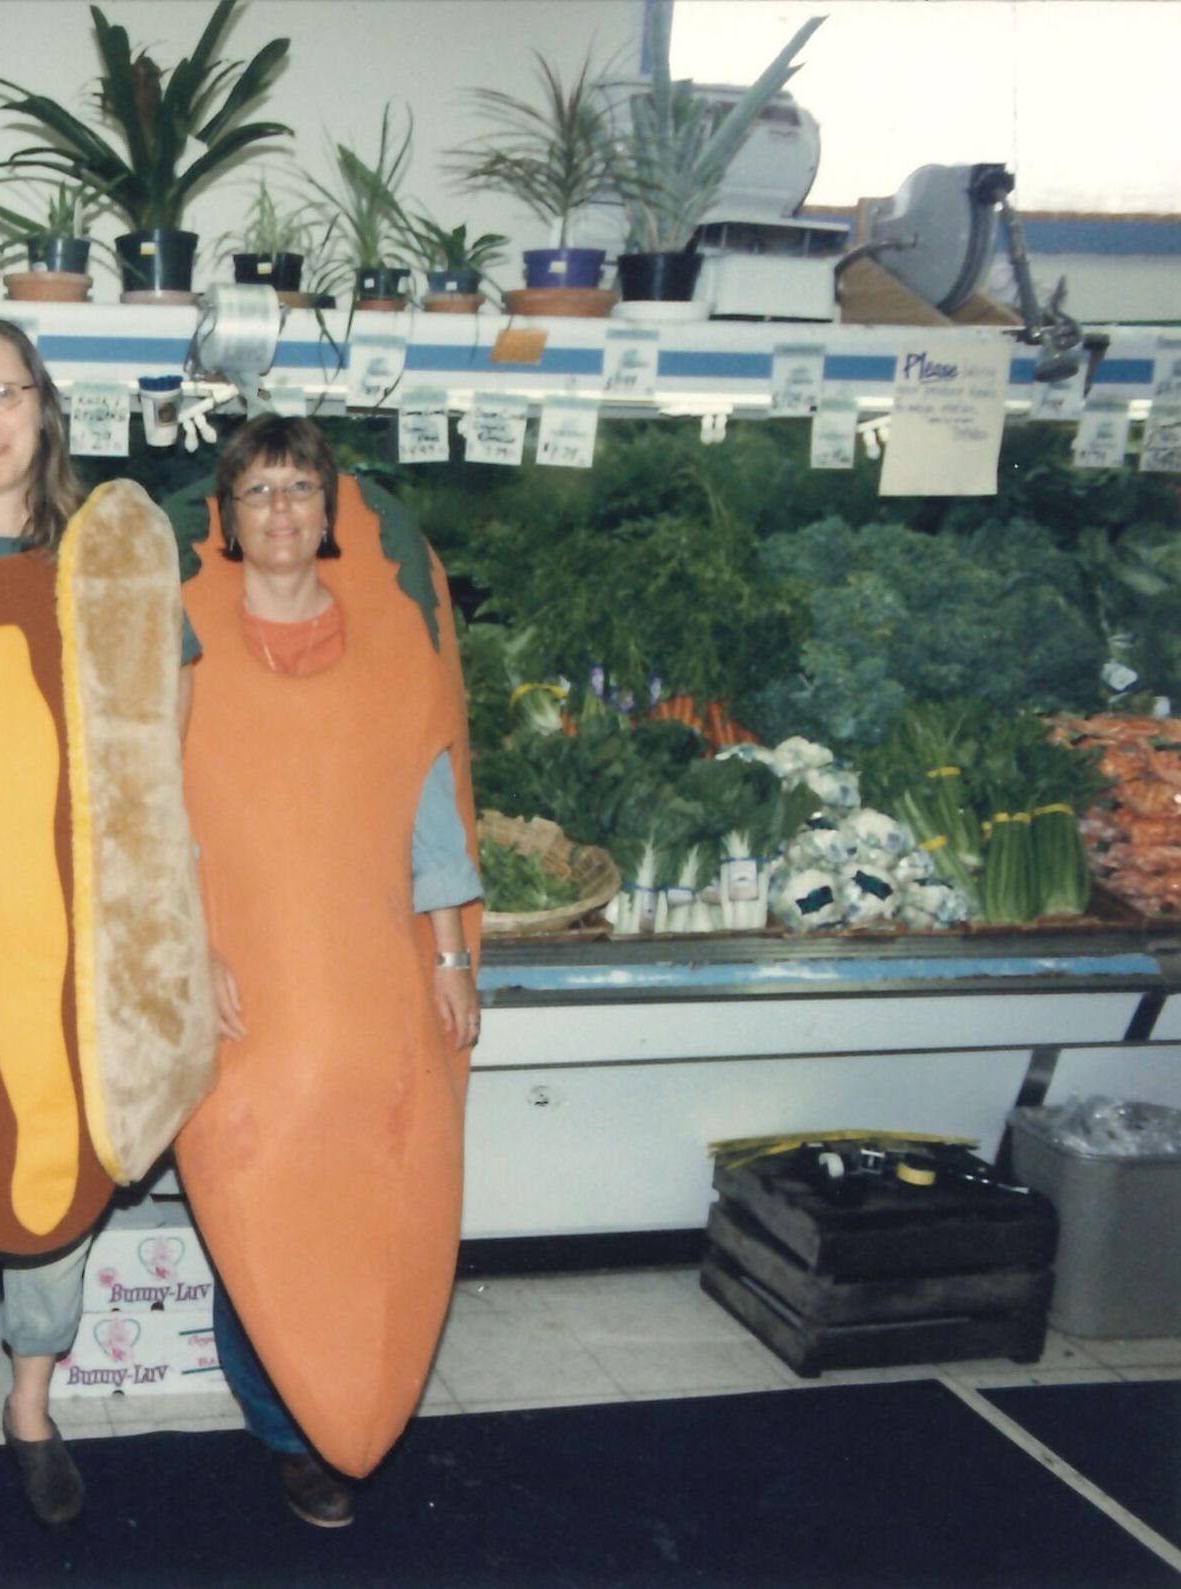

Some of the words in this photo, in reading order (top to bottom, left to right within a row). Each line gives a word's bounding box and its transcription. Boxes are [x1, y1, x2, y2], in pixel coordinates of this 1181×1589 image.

[903, 351, 959, 381] Please
[109, 1282, 212, 1303] Bunny-Luv
[67, 1364, 169, 1386] Bunny-Luv
